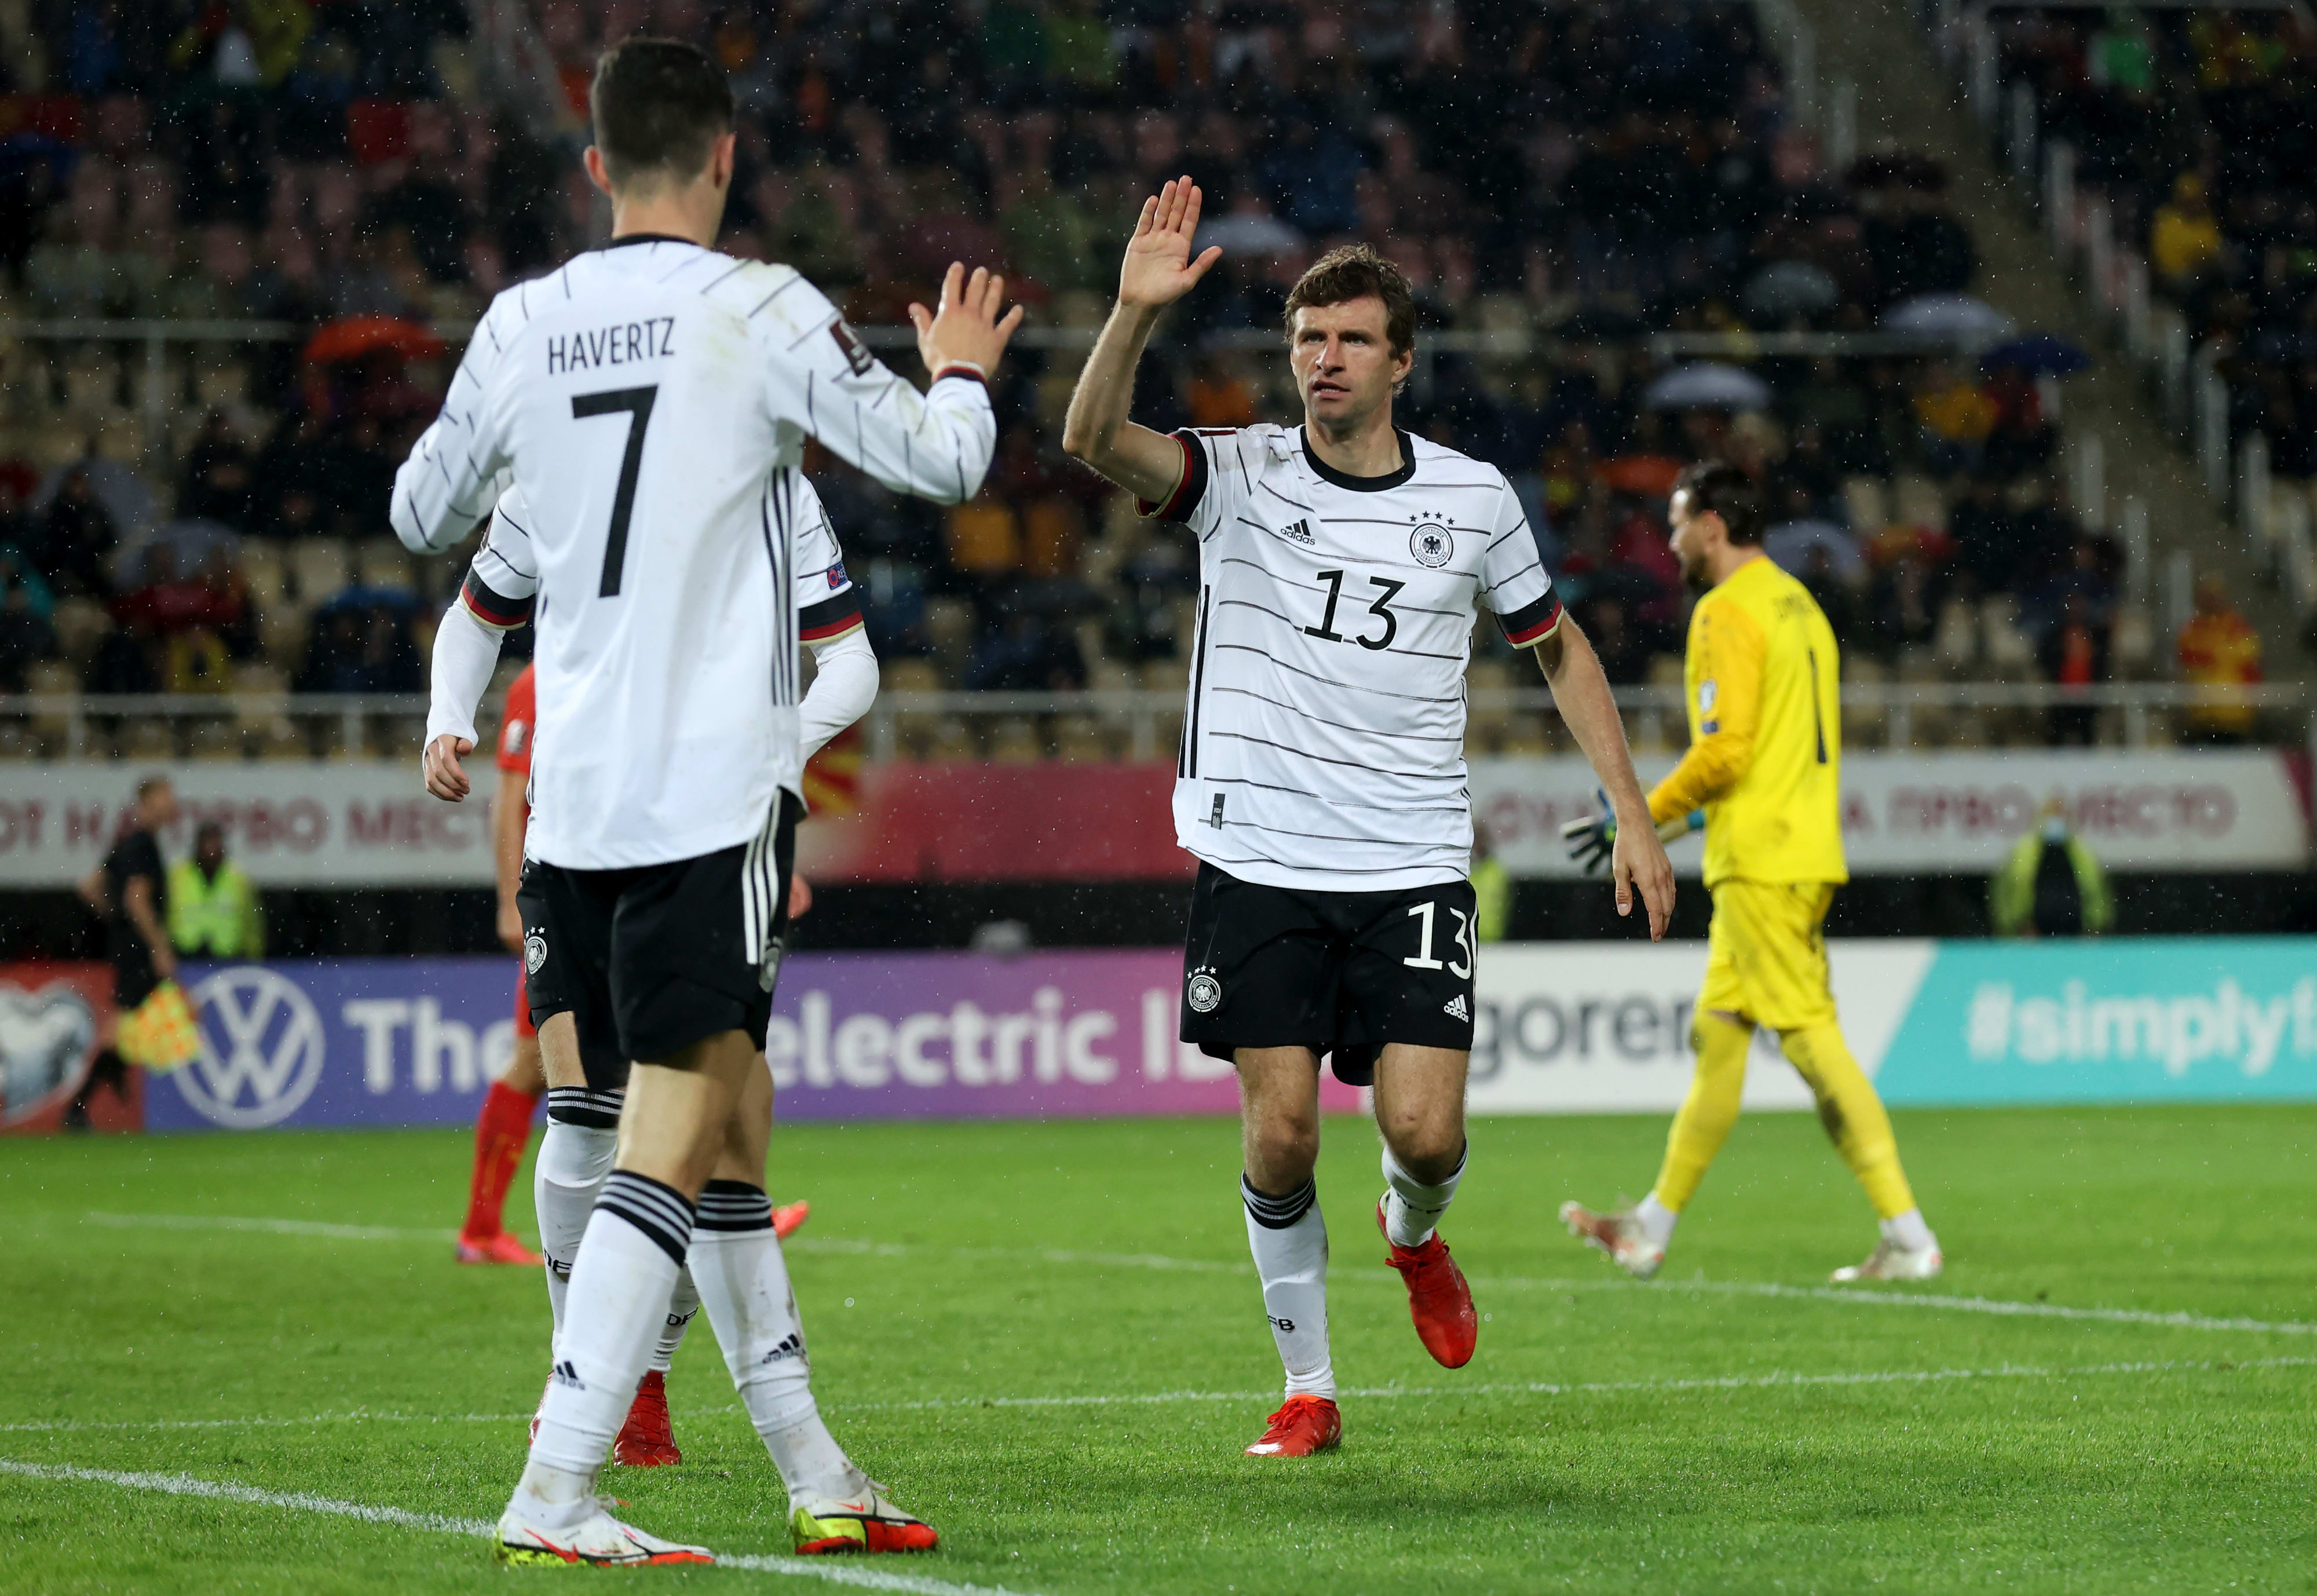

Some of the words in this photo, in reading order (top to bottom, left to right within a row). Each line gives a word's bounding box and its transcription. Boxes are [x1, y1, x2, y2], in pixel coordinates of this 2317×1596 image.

[548, 317, 675, 375] HAVERTZ
[571, 384, 659, 598] 7
[1280, 528, 1315, 545] adidas
[1419, 528, 1445, 538] DEUTSCHER
[1304, 569, 1406, 651] 13
[1809, 648, 1828, 764] 1
[1404, 901, 1471, 980] 13
[1443, 1005, 1469, 1023] adidas
